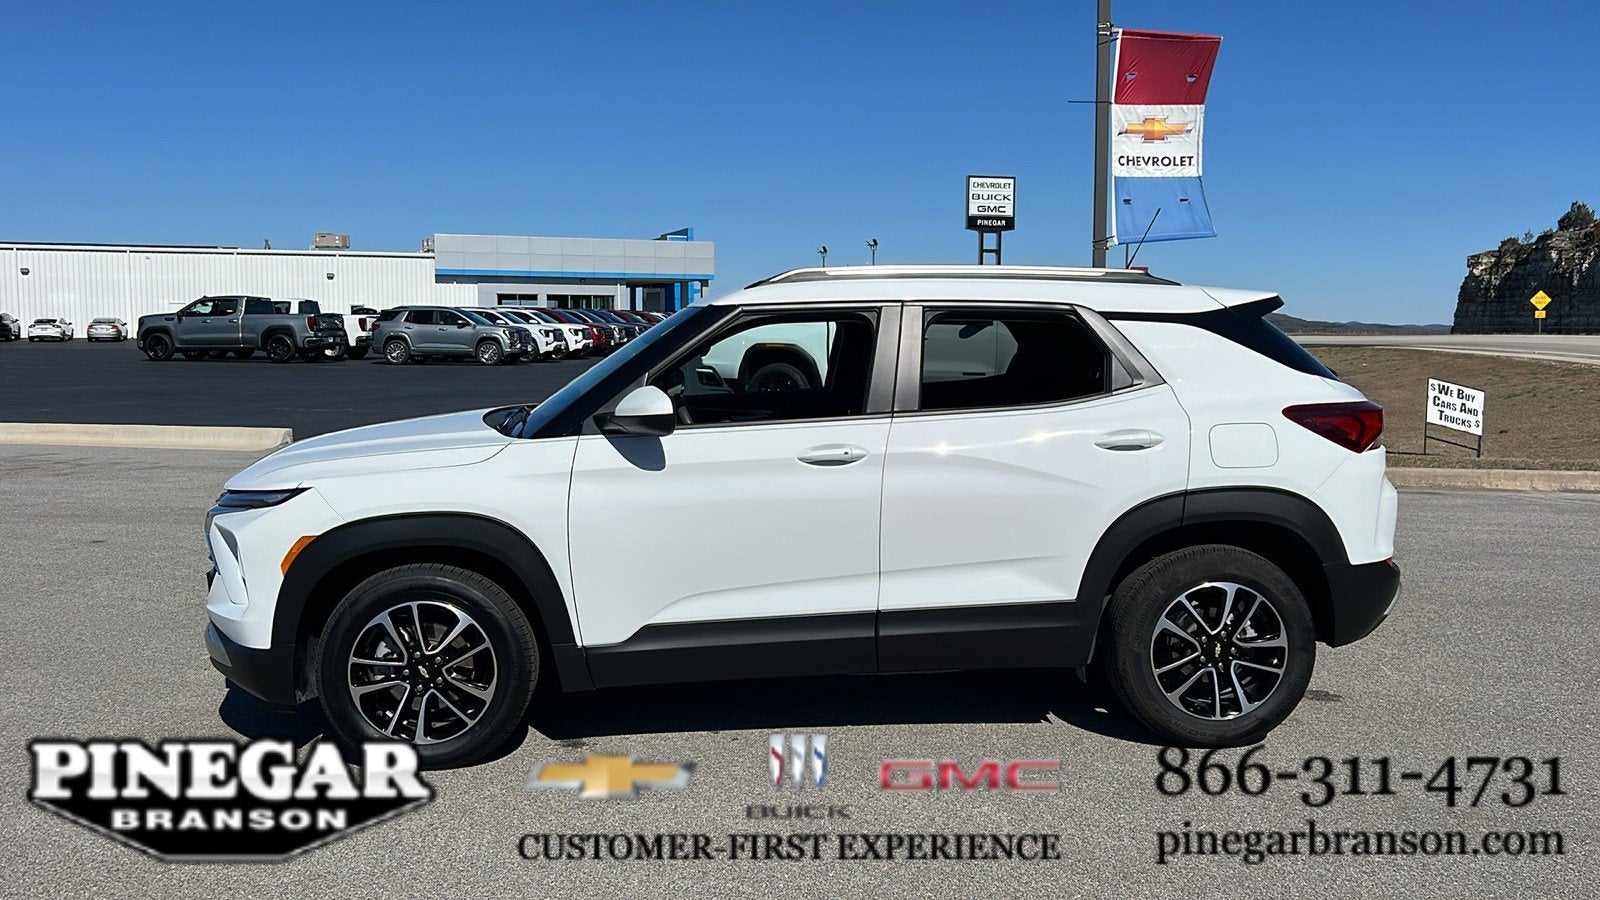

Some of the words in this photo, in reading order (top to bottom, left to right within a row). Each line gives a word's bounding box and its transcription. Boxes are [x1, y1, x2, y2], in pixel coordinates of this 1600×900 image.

[1118, 155, 1194, 167] CHEVROLET
[972, 181, 1012, 189] CHEVROLET
[971, 193, 1012, 201] BUICK
[977, 205, 1006, 213] GMC
